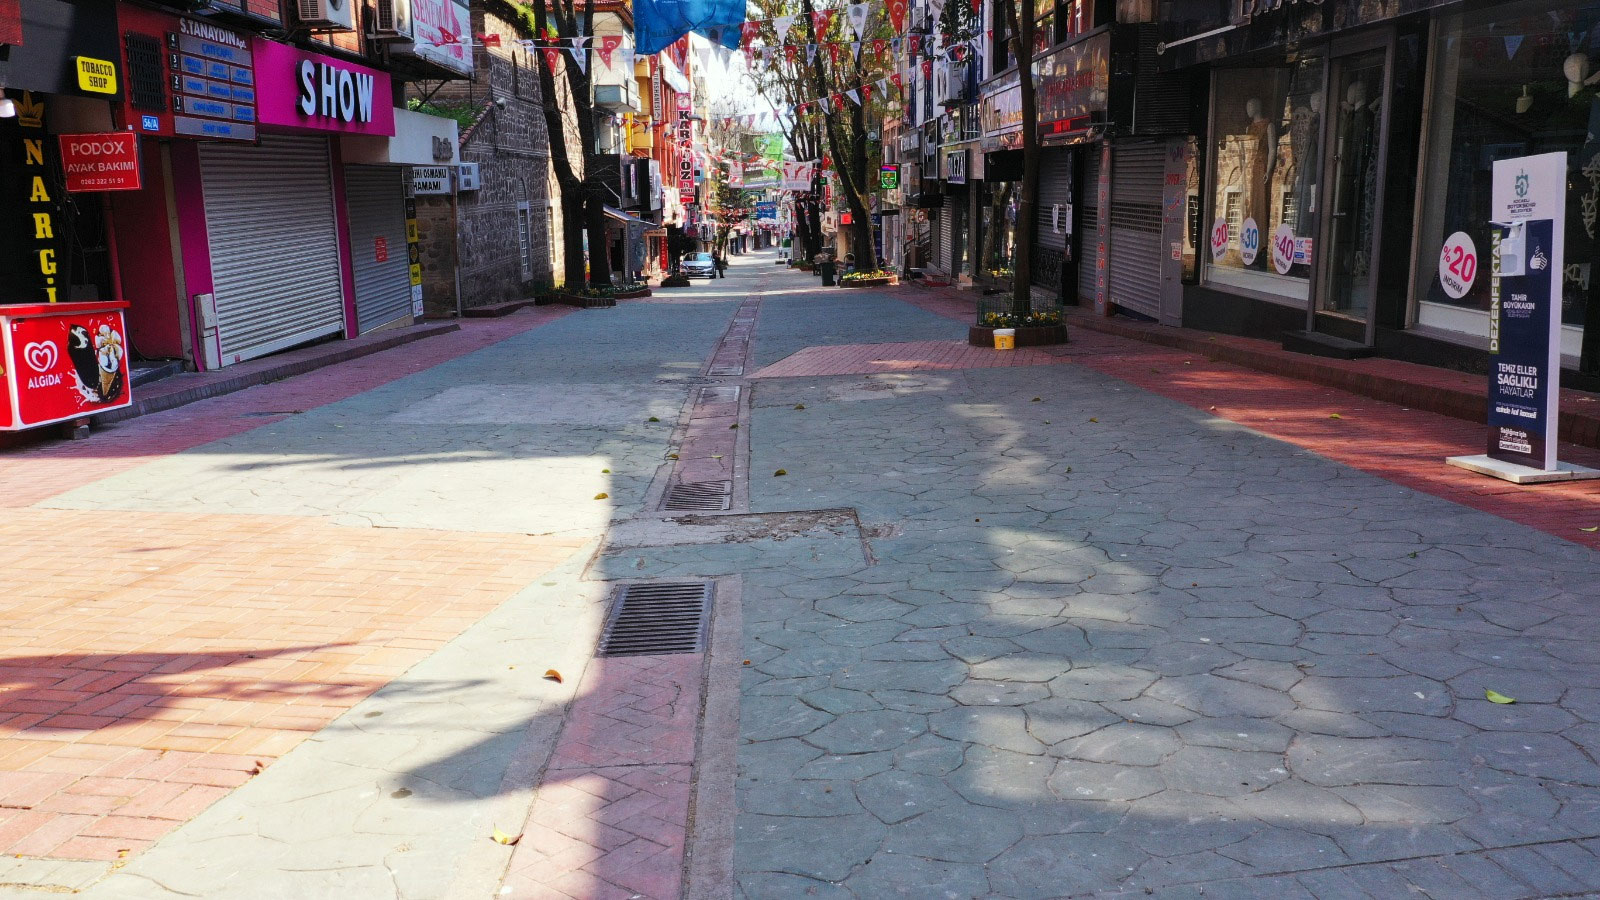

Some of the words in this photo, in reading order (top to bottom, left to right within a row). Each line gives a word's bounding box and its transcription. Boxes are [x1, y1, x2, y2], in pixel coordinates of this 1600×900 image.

[180, 17, 236, 46] S.TANAYDIN
[173, 54, 177, 63] 3
[81, 60, 113, 77] TOBACCO
[88, 76, 108, 89] SHOP
[174, 75, 179, 85] 2
[299, 58, 374, 123] SHOW
[143, 118, 158, 129] 56/A
[70, 141, 126, 156] PODOX
[67, 163, 96, 173] AYAK
[98, 161, 135, 172] BAKIMI
[413, 181, 441, 191] HAMAMI
[1211, 223, 1228, 248] %20
[1240, 228, 1258, 250] %30
[1274, 234, 1294, 262] %40
[1442, 245, 1476, 283] %20
[1443, 273, 1463, 294] İNDİRİM
[1491, 233, 1501, 352] DEZENFEKTAN
[1511, 293, 1527, 302] TAHİR
[1503, 300, 1535, 310] BÜYÜKAKIN
[1497, 362, 1516, 374] TEMİZ
[1517, 365, 1537, 376] ELLER
[1499, 385, 1534, 399] HAYATLAR
